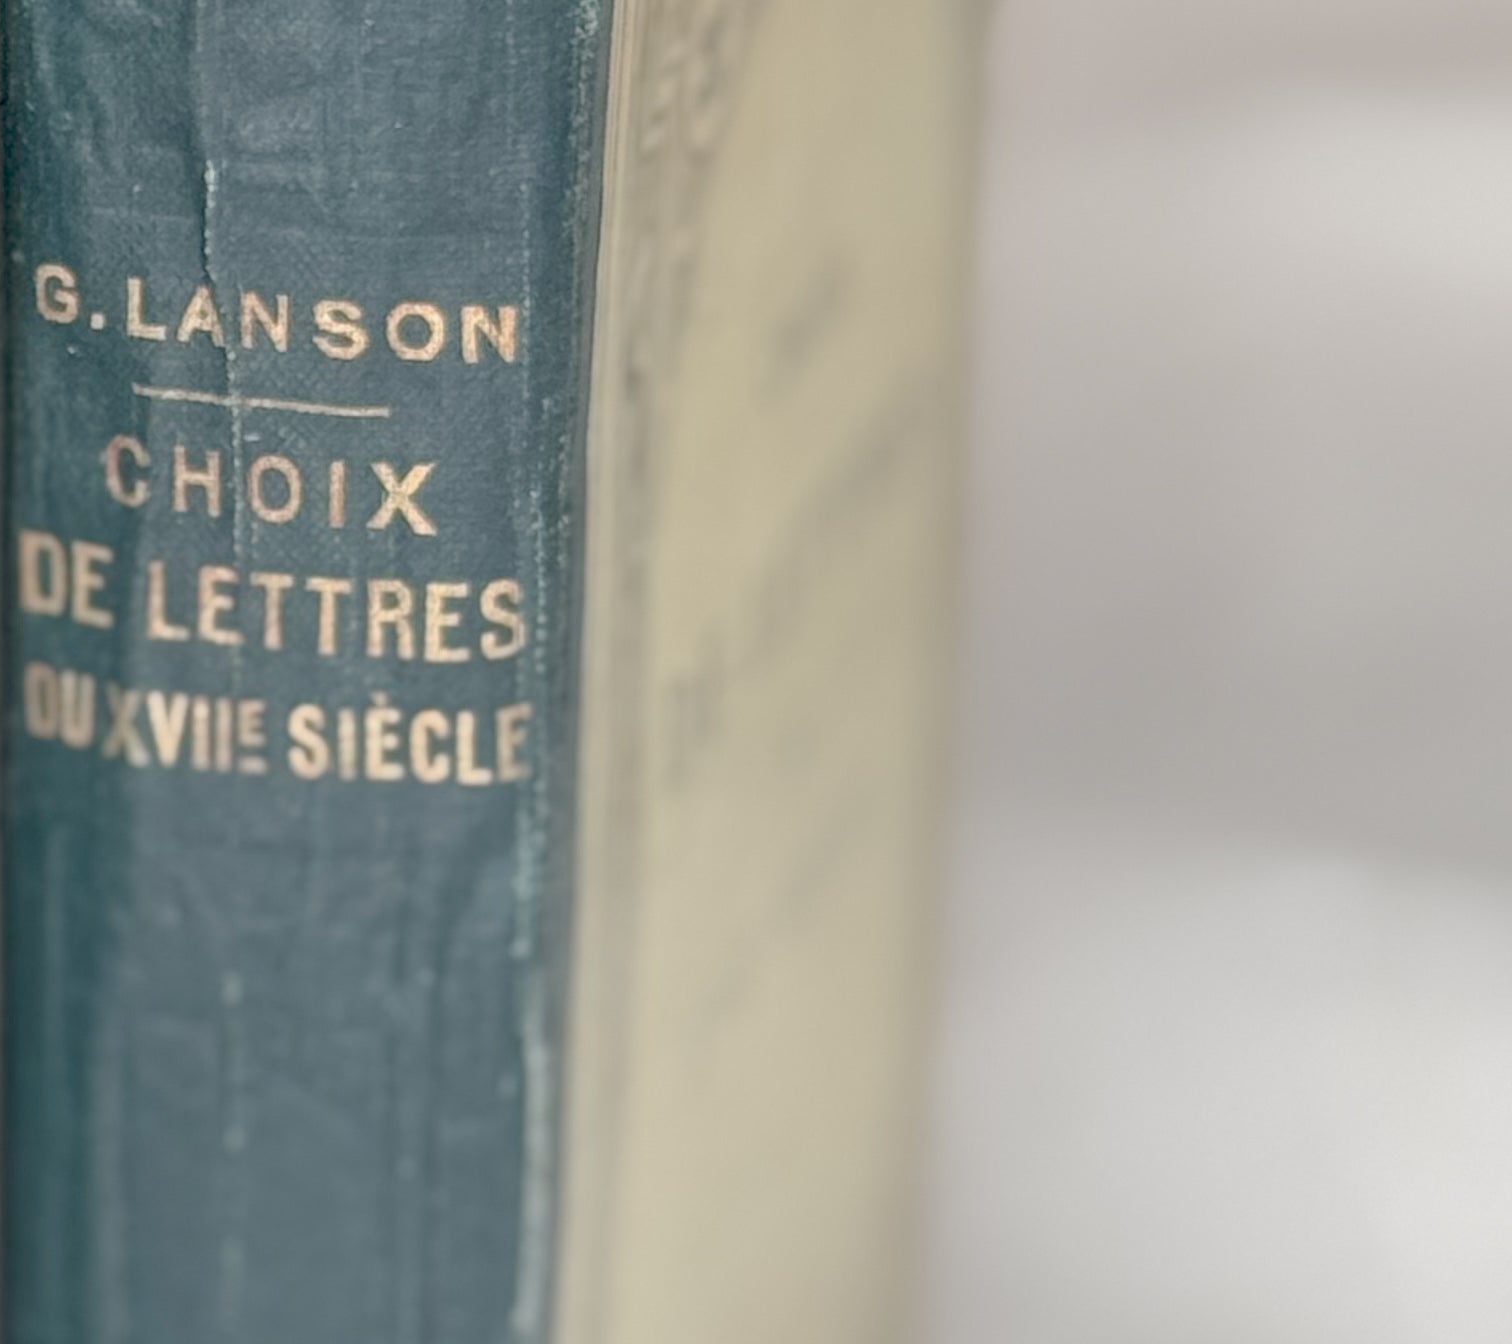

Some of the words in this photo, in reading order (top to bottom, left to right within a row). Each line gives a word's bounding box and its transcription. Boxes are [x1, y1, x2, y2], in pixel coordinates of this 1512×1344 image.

[103, 433, 439, 537] CHOIX
[16, 528, 115, 630] DE
[145, 559, 527, 663] LETTRES
[22, 660, 97, 748] DU
[287, 692, 534, 786] SIÈCLE
